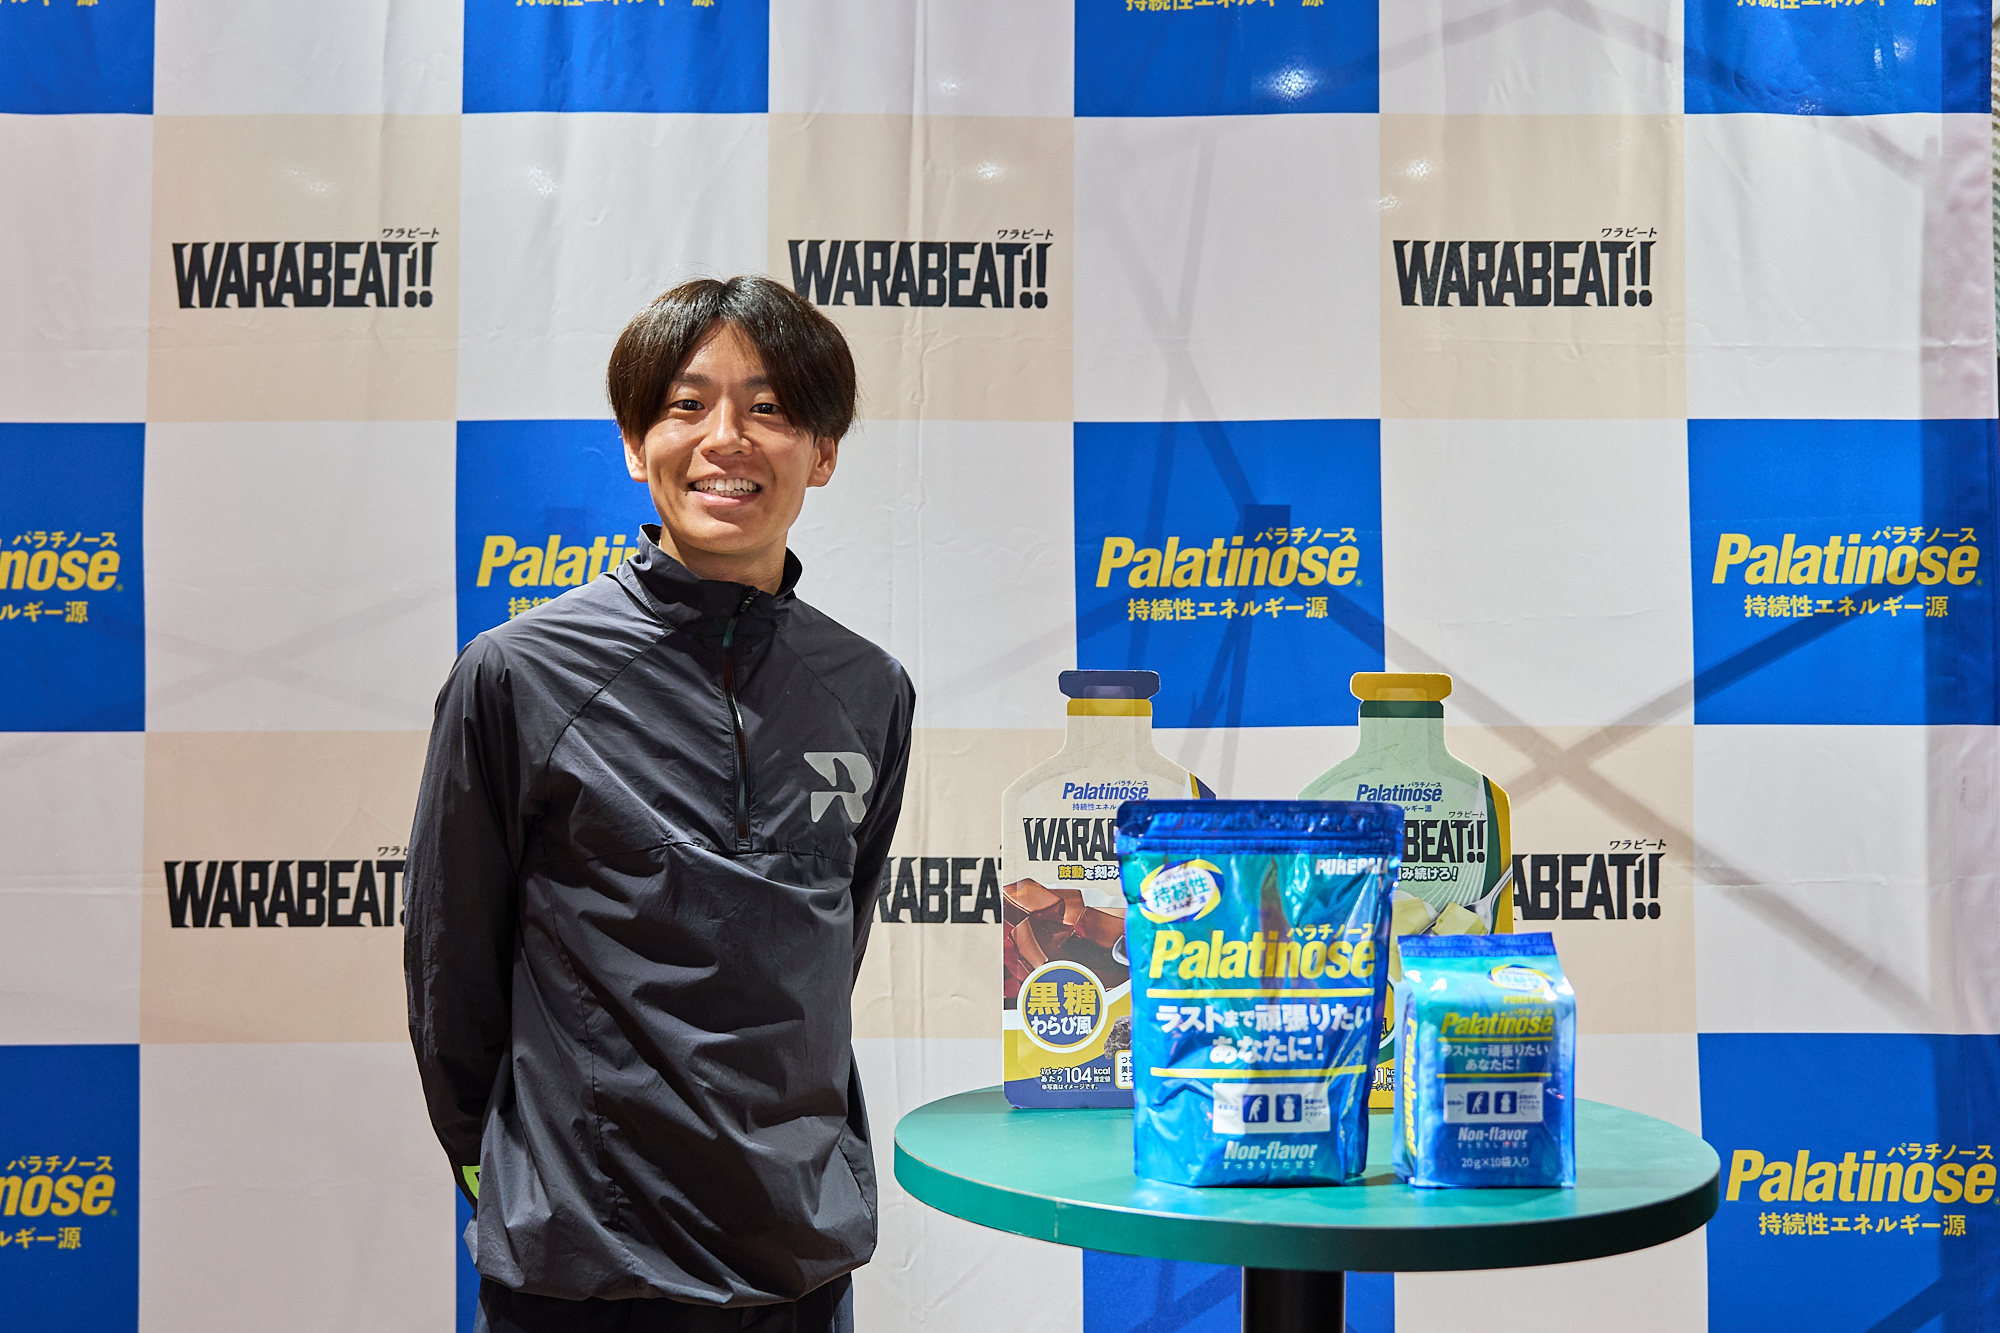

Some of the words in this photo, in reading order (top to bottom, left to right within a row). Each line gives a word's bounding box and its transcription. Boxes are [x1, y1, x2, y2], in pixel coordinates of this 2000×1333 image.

[382, 227, 440, 239] ワラビート
[997, 229, 1054, 240] ワラビート
[1601, 227, 1657, 238] ワラビート
[172, 241, 440, 309] WARABEAT!!
[788, 240, 1053, 308] WARABEAT!!
[1393, 240, 1657, 306] WARABEAT!!
[12, 530, 118, 549] パラチノース
[1255, 527, 1357, 545] パラチノース
[1871, 526, 1977, 544] パラチノース
[1095, 536, 1360, 588] Palatinose
[1711, 533, 1980, 586] Palatinose
[0, 549, 120, 591] nose
[1127, 596, 1329, 621] 持続性エネルギー源
[1744, 594, 1949, 618] 持続性エネルギー源
[1609, 839, 1667, 850] ワラビート
[1398, 866, 1459, 880] み続けろ!
[164, 860, 405, 928] WARABEAT
[1149, 930, 1375, 980] Palatinose
[1027, 982, 1097, 1016] 黒糖
[1031, 1015, 1093, 1035] わらび風
[1440, 1011, 1555, 1034] Palatinose
[1065, 1067, 1092, 1083] 104
[1093, 1066, 1111, 1075] kcal
[1458, 1126, 1528, 1141] Non-flavor
[1224, 1140, 1318, 1160] Non-flavor
[1887, 1142, 1994, 1161] パラチノース
[6, 1155, 114, 1174] パラチノース
[1725, 1149, 1998, 1203] Palatinose
[1758, 1212, 1967, 1236] 持続性エネルギー源
